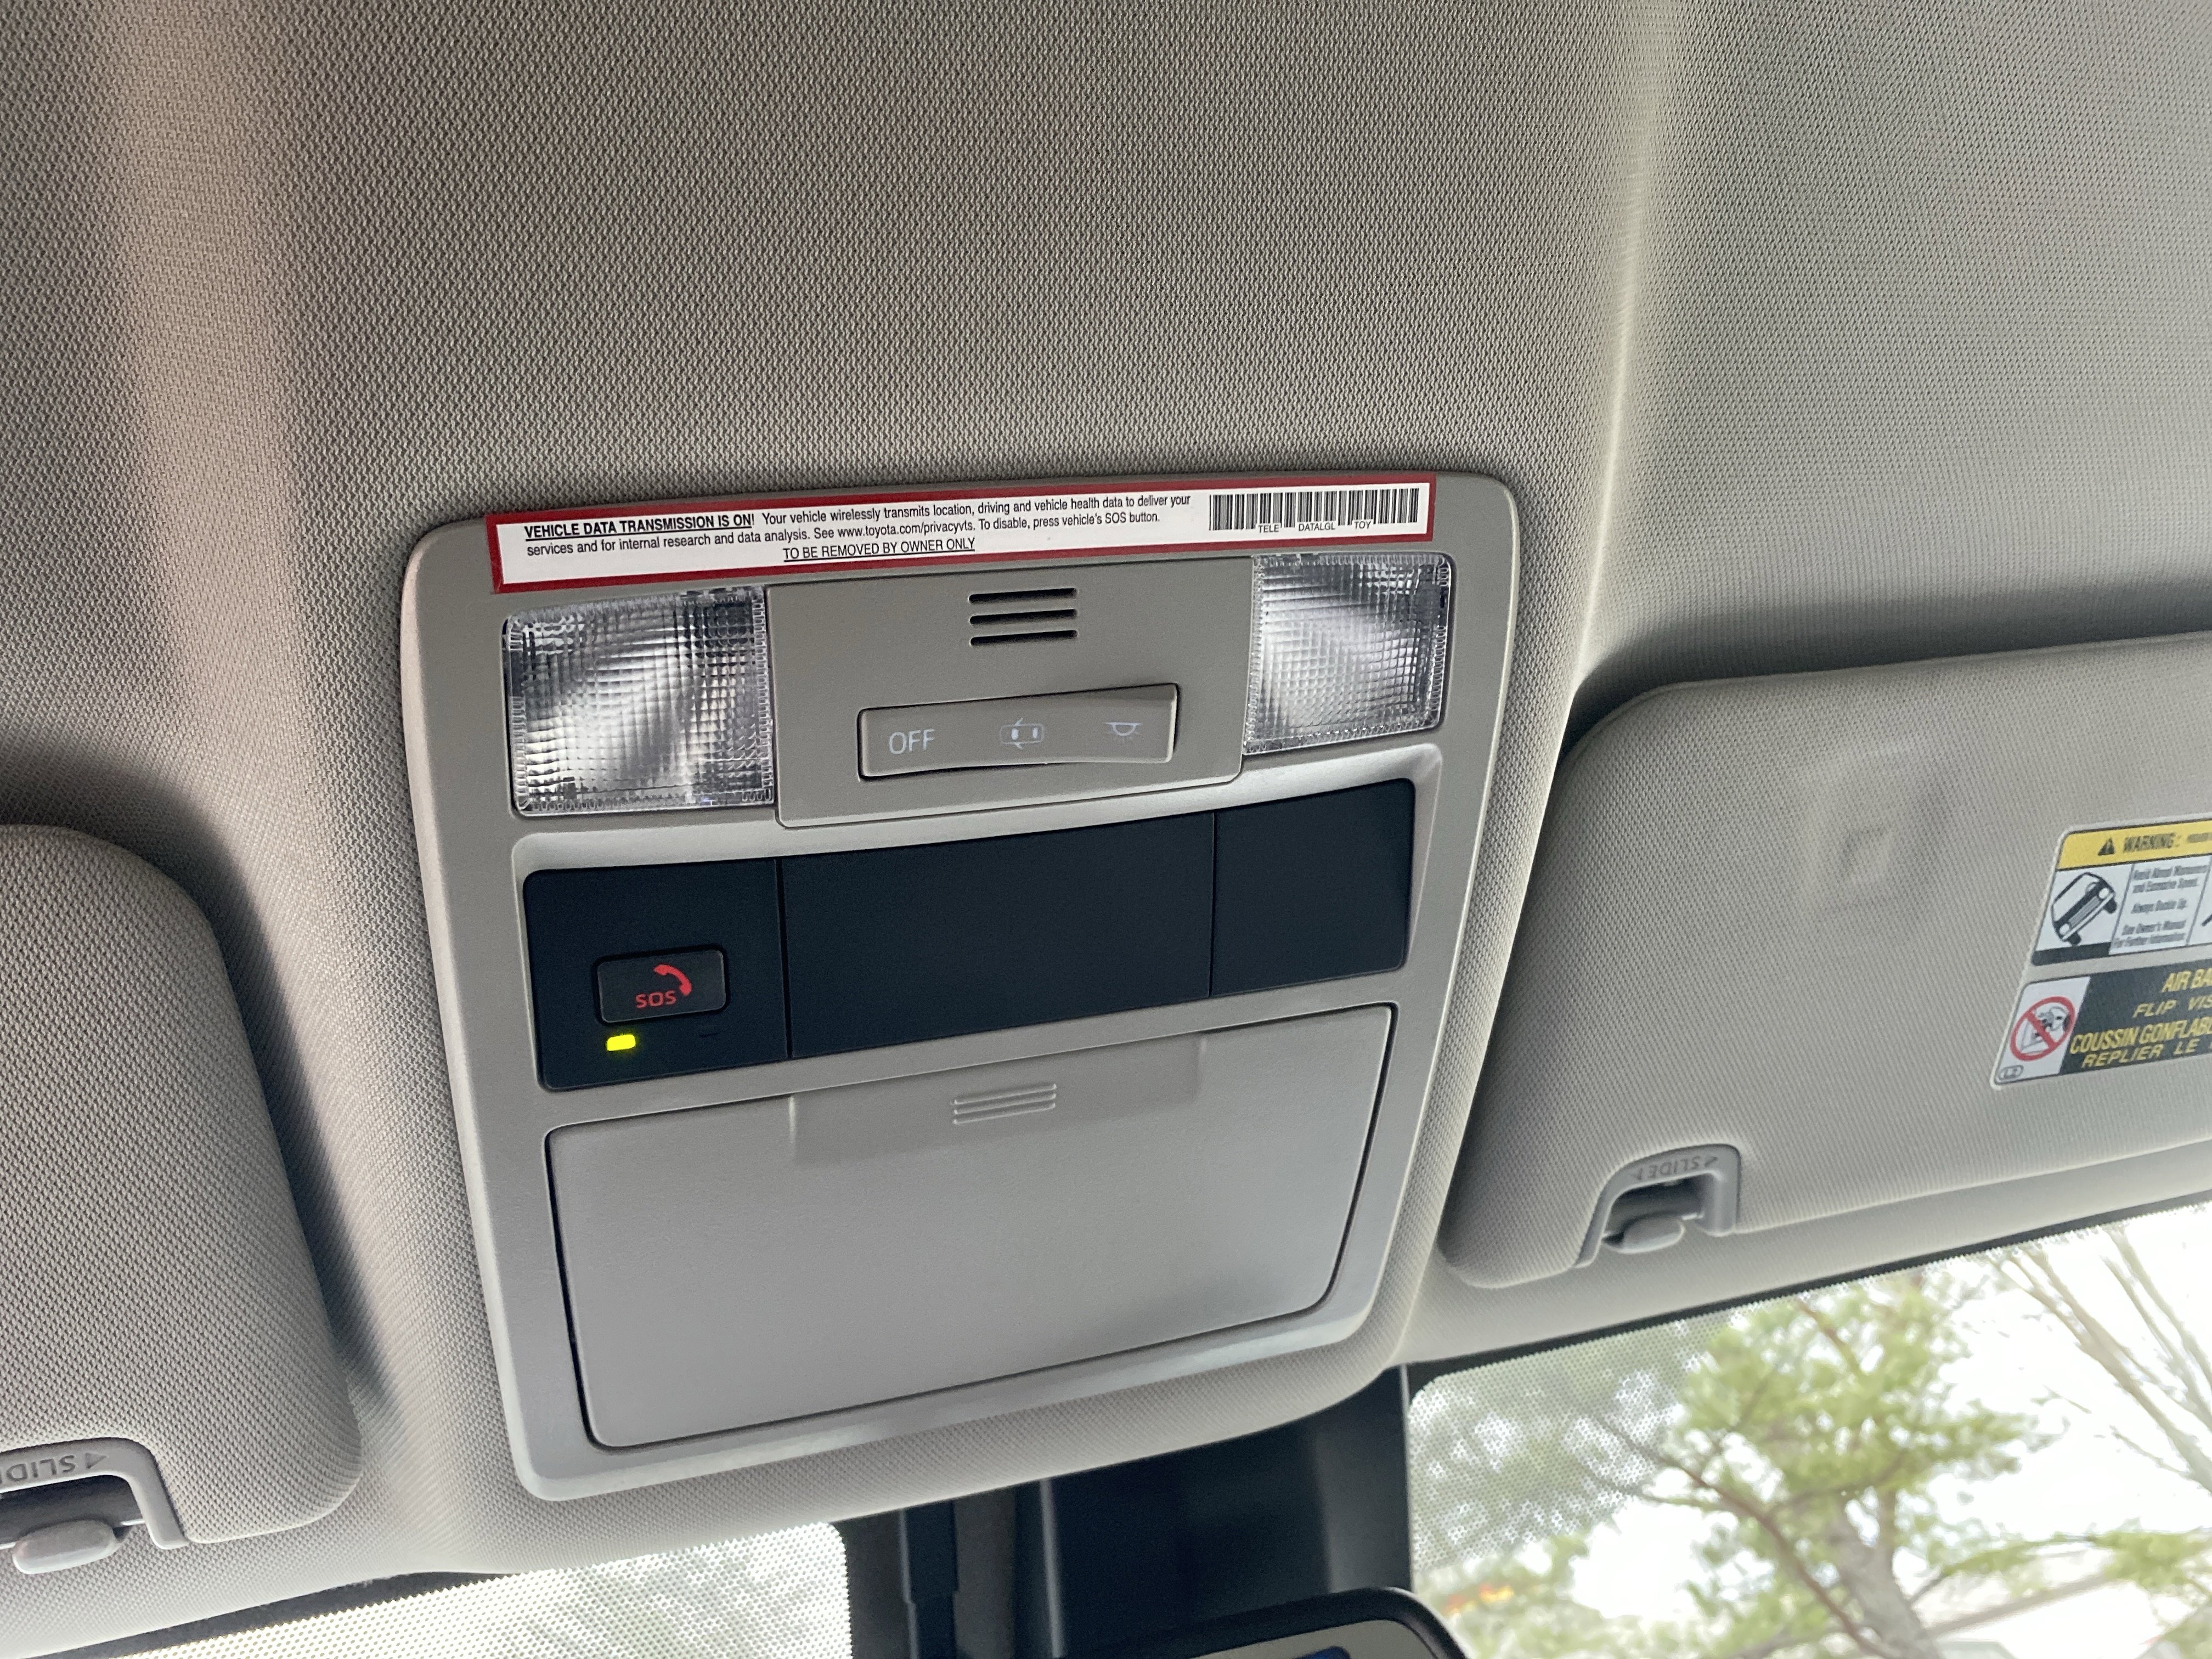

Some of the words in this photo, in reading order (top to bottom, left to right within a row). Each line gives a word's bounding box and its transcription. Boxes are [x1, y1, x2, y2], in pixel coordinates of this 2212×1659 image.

[524, 523, 580, 538] VEHICLE
[583, 521, 617, 535] DATA
[619, 515, 714, 533] TRANSMISSION
[718, 515, 730, 527] IS
[733, 514, 755, 526] ON!
[762, 512, 787, 525] Your
[791, 510, 827, 523] vehicle
[830, 507, 881, 522] wirelessly
[884, 505, 930, 519] transmits
[933, 503, 974, 516] location,
[978, 501, 1010, 516] driving
[1013, 500, 1031, 512] and
[1035, 498, 1068, 511] vehicle
[1071, 496, 1100, 509] health
[1103, 496, 1124, 509] data
[1126, 496, 1135, 507] to
[1138, 494, 1167, 506] deliver
[1170, 495, 1191, 508] your
[1258, 524, 1279, 533] TELE
[1299, 522, 1336, 532] DATALGL
[1355, 520, 1371, 530] TOY
[527, 542, 573, 556] services
[577, 540, 597, 552] and
[601, 539, 616, 551] for
[619, 536, 659, 549] internal
[663, 533, 711, 548] research
[714, 532, 734, 544] and
[737, 530, 761, 543] data
[765, 528, 810, 543] analysis.
[814, 527, 834, 539] See
[838, 521, 976, 538] www.toyota.com/privacyvts.
[978, 518, 990, 531] To
[993, 517, 1031, 530] disable,
[1033, 517, 1059, 531] press
[1062, 513, 1102, 526] vehicle's
[1105, 512, 1127, 524] SOS
[1129, 510, 1160, 523] button.
[783, 548, 799, 560] TO
[803, 546, 818, 558] BE
[822, 542, 879, 557] REMOVED
[883, 542, 898, 554] BY
[900, 540, 943, 552] OWNER
[946, 537, 975, 550] ONLY
[888, 728, 935, 755] OFF
[2161, 970, 2192, 994] AIR
[635, 990, 676, 1008] SOS
[2132, 1000, 2177, 1019] FLIP
[2070, 1027, 2140, 1054] COUSSIN
[2081, 1043, 2164, 1069] REPLIER
[2173, 1039, 2200, 1056] LE
[1647, 1155, 1701, 1178] SLIDE
[0, 1454, 76, 1483] SLID
